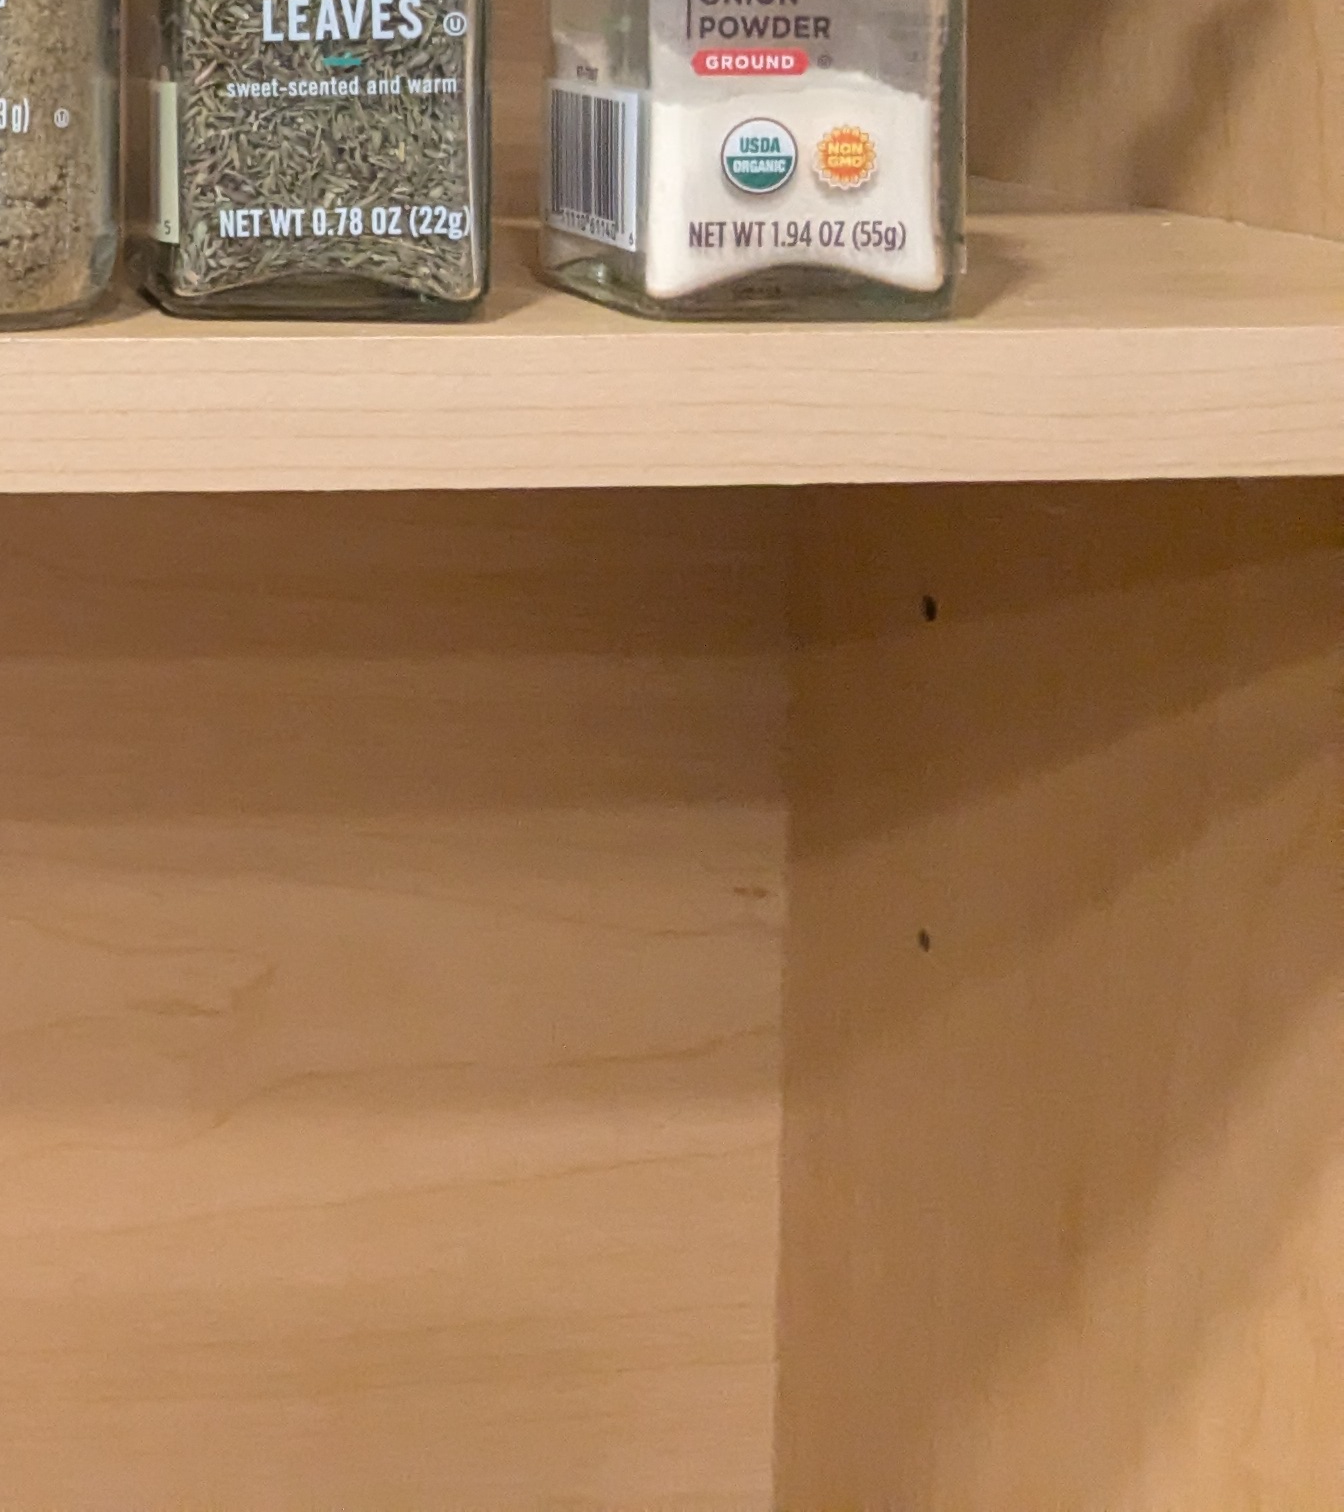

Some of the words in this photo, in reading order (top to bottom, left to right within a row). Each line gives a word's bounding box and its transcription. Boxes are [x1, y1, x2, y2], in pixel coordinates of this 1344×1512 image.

[699, 16, 831, 40] POWDER
[705, 55, 795, 70] GROUND
[226, 77, 359, 98] sweet-scented
[366, 75, 400, 95] and
[407, 77, 457, 94] warm
[740, 137, 780, 154] USDA
[828, 142, 863, 156] NON
[732, 158, 786, 174] ORGANIC
[828, 155, 861, 168] GMO
[219, 209, 263, 238] NET
[270, 208, 305, 237] WT
[312, 207, 363, 236] 0.78
[371, 207, 402, 235] OZ
[409, 206, 472, 240] (22g)
[689, 222, 725, 248] NET
[732, 222, 768, 248] WT
[772, 222, 811, 247] 1.94
[819, 221, 845, 247] OZ
[852, 220, 906, 251] (55g)
